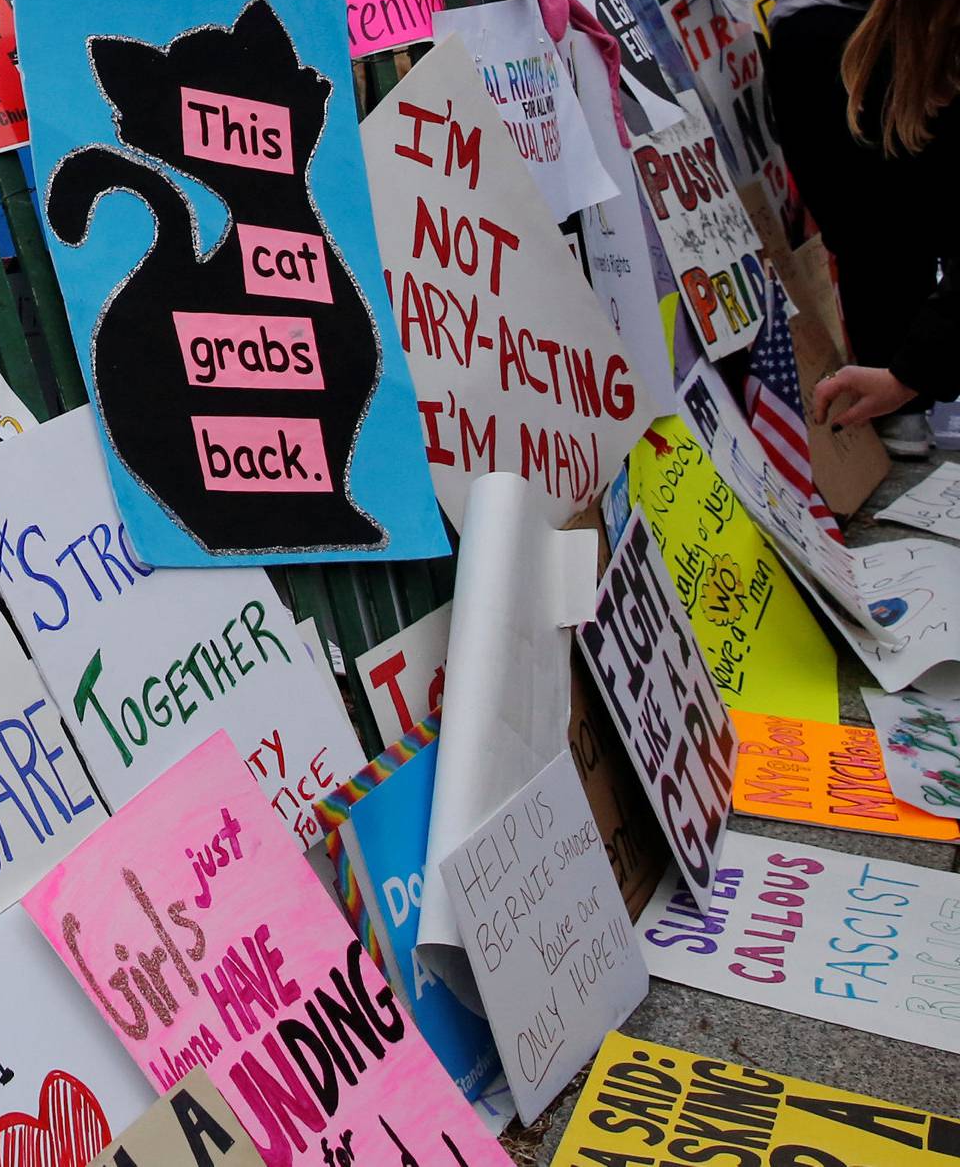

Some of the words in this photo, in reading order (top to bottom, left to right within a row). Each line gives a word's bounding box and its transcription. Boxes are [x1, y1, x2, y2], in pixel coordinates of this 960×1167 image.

[727, 49, 759, 90] SAY
[187, 100, 282, 161] This
[395, 99, 482, 190] I'M
[633, 136, 730, 221] PUSSY
[251, 242, 317, 284] cat
[411, 196, 520, 297] NOT
[383, 268, 635, 421] ARY-ACTING
[680, 253, 766, 346] PRID
[189, 325, 315, 385] grabs
[201, 429, 324, 482] back.
[417, 390, 496, 473] I'M
[521, 422, 601, 505] MAD!
[581, 519, 672, 739] FIGHT
[73, 600, 294, 768] TOGETHER
[271, 747, 335, 821] TICE
[660, 680, 736, 889] GIRL
[744, 767, 813, 809] MY
[454, 814, 521, 918] HELP
[523, 790, 555, 841] US
[61, 866, 208, 1042] Girls
[185, 807, 244, 910] just
[476, 855, 555, 973] BERNIE
[728, 852, 826, 985] CALLOUS
[815, 862, 920, 1004] FASCIST
[201, 923, 303, 1043] HAVE
[220, 938, 406, 1167] UNDING
[515, 985, 566, 1084] ONLY
[588, 1050, 682, 1147] SAID:
